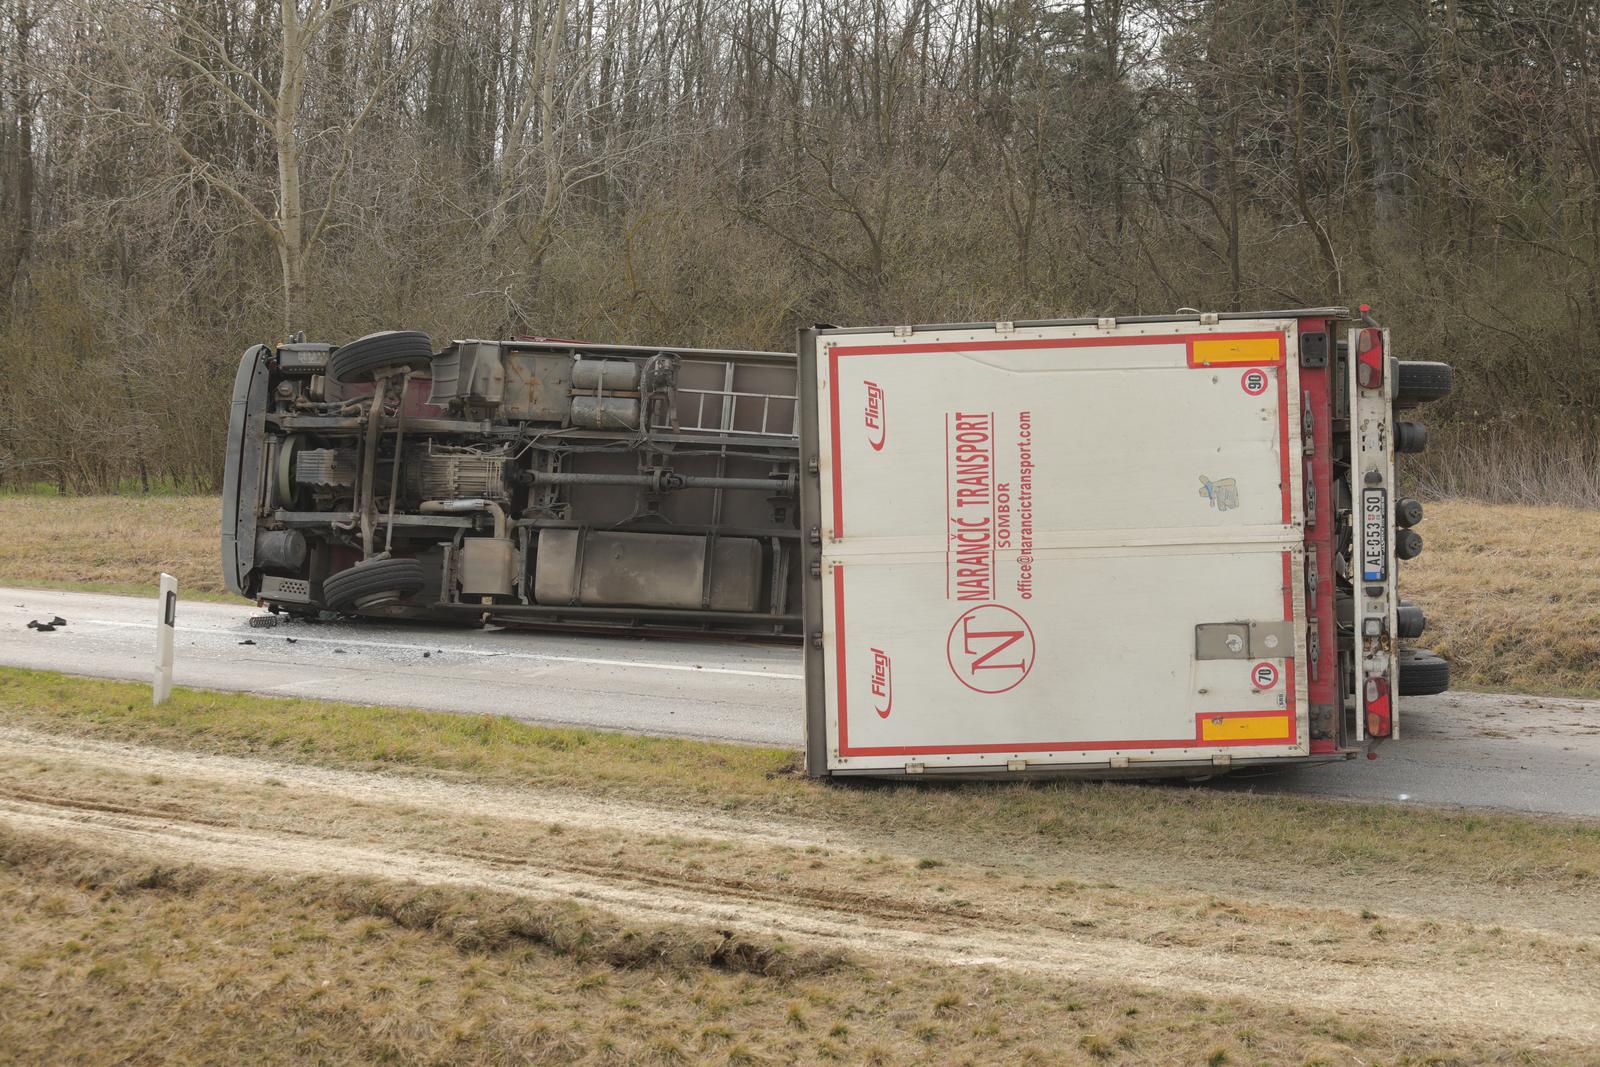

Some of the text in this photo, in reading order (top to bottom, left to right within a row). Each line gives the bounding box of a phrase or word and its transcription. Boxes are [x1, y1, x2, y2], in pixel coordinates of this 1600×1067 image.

[864, 380, 882, 430] Fliegl
[1247, 374, 1262, 390] 90
[951, 412, 990, 601] NARANČIĆ TRANSPORT
[997, 482, 1011, 548] SOMBOR
[1016, 411, 1036, 600] office@narancictransport.com
[870, 647, 889, 698] Fliegl
[963, 615, 1026, 676] NT
[1257, 669, 1272, 683] 70
